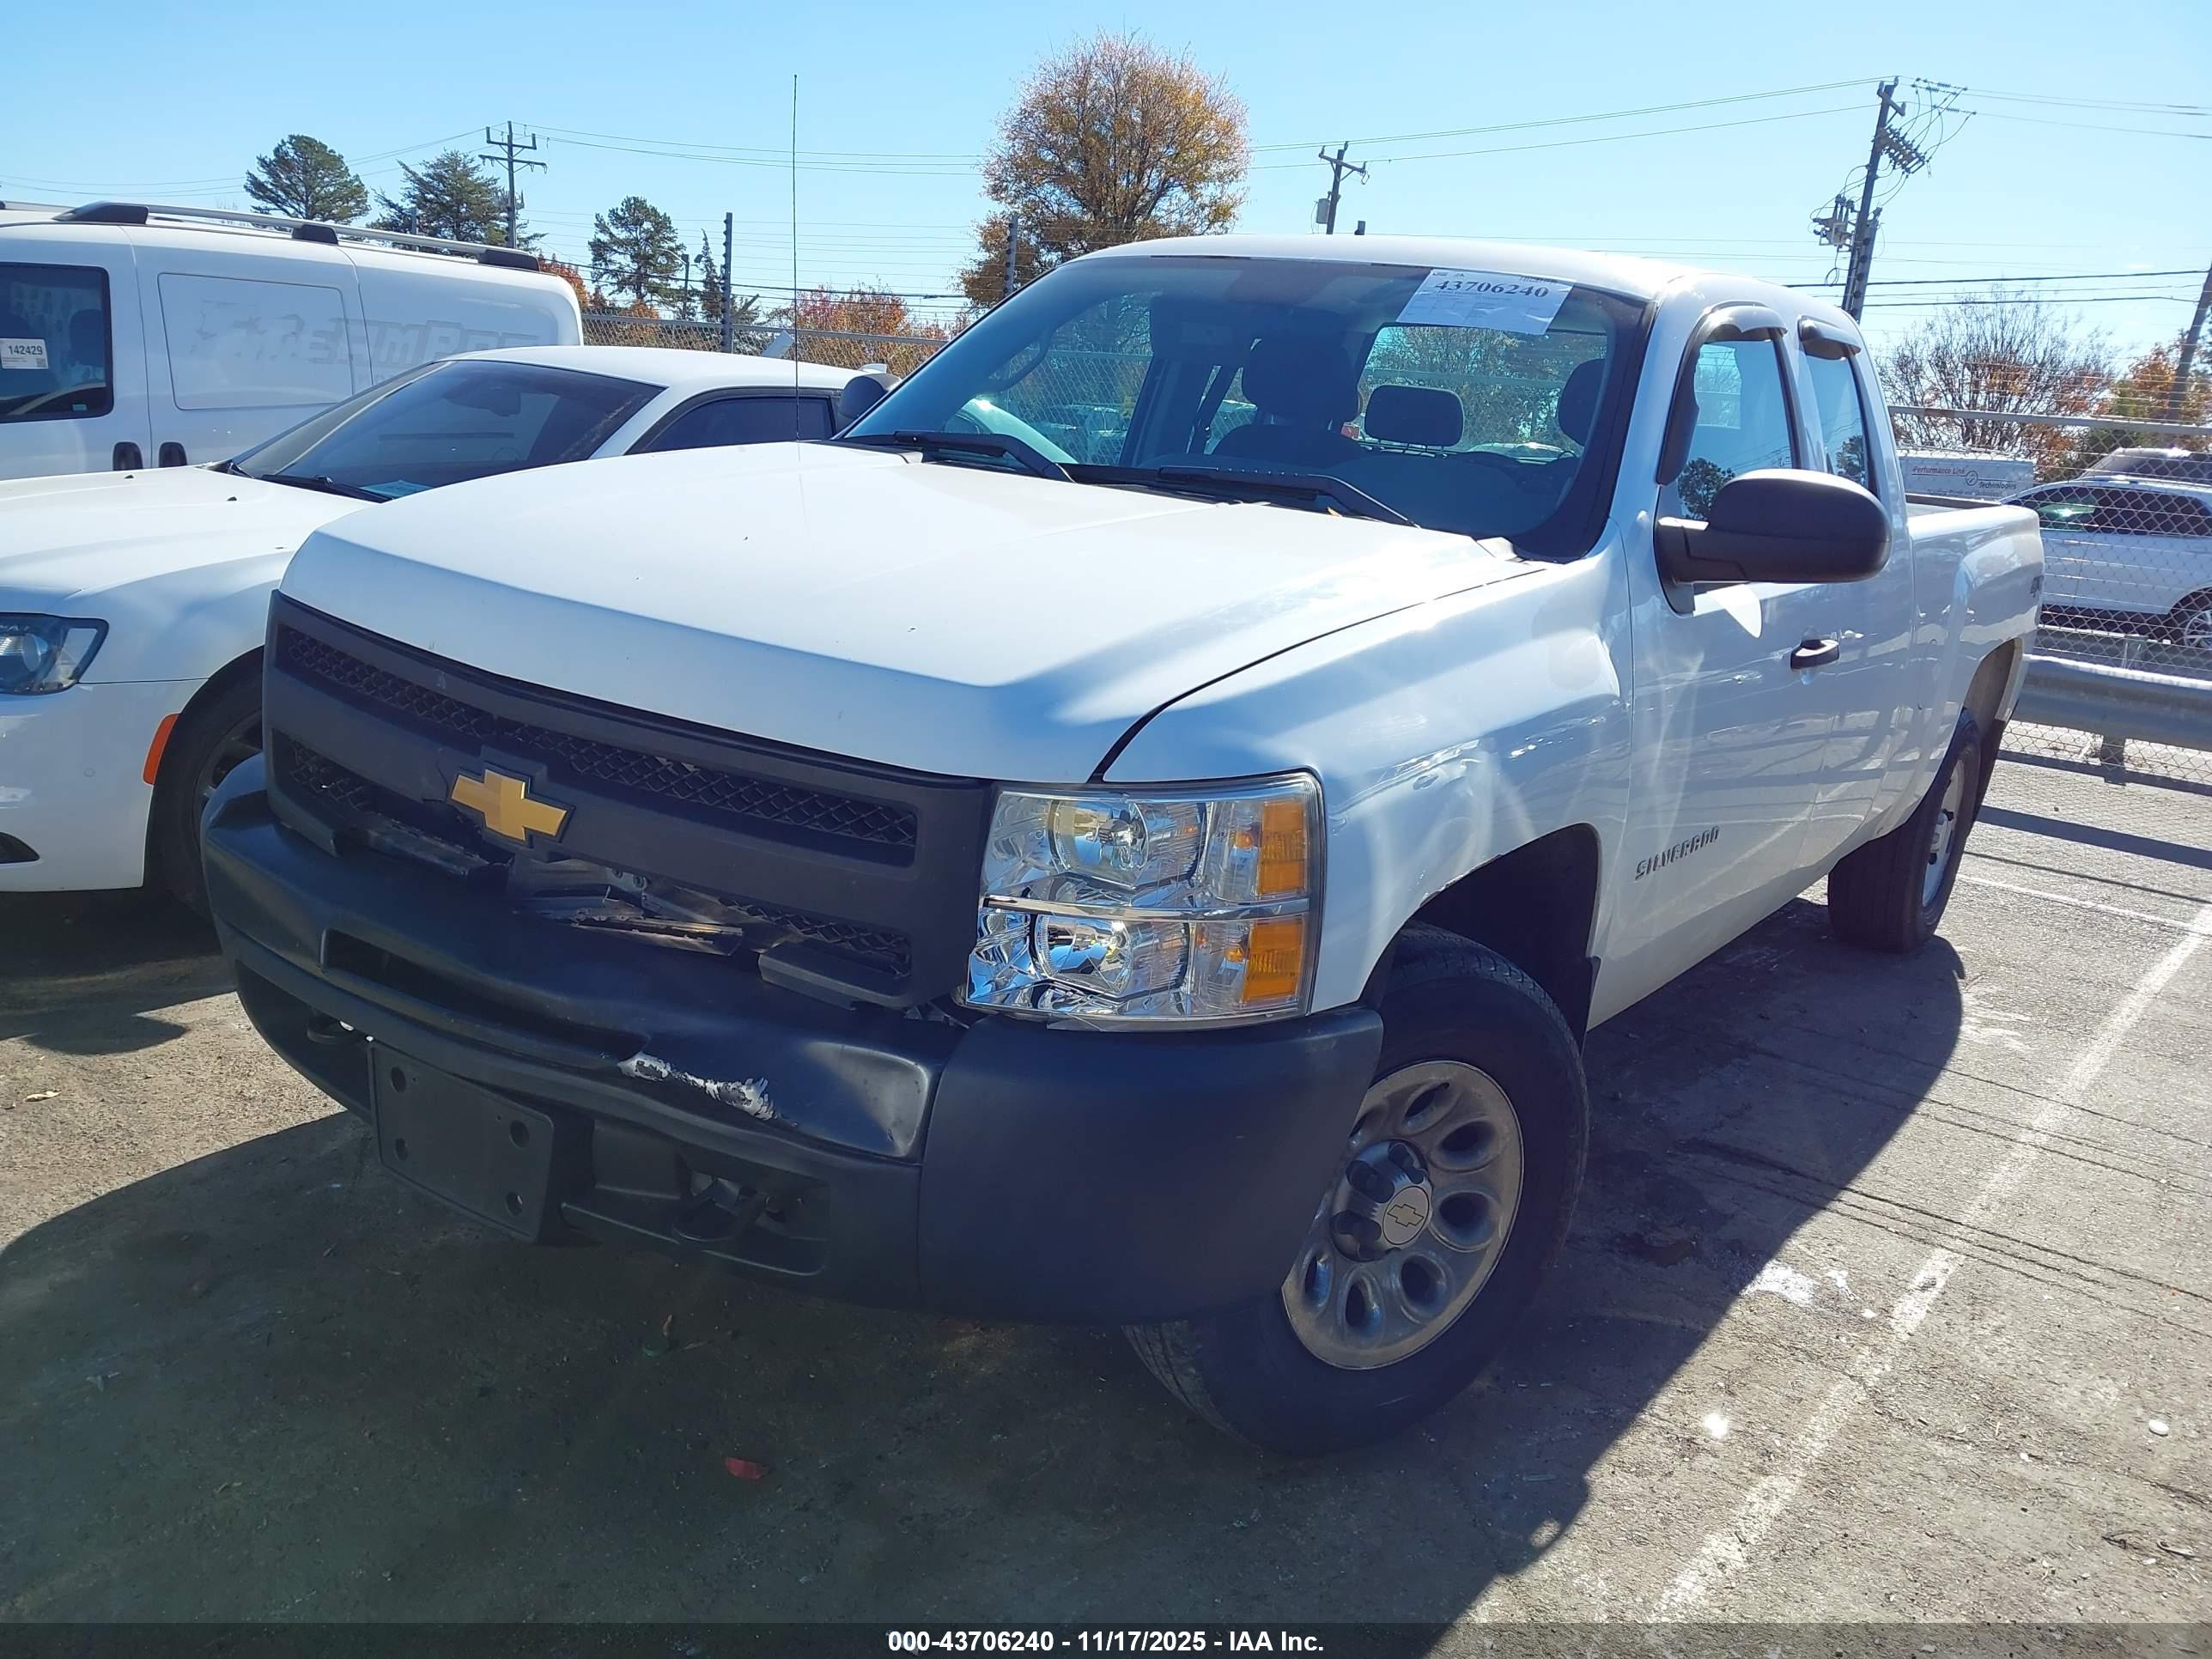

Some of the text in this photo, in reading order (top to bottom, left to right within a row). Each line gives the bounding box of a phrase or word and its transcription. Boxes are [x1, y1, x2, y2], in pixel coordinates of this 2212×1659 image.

[1435, 280, 1549, 297] 43706240
[9, 344, 43, 356] 142429
[1912, 465, 1952, 474] Performance
[1635, 825, 1720, 881] SILVERADO
